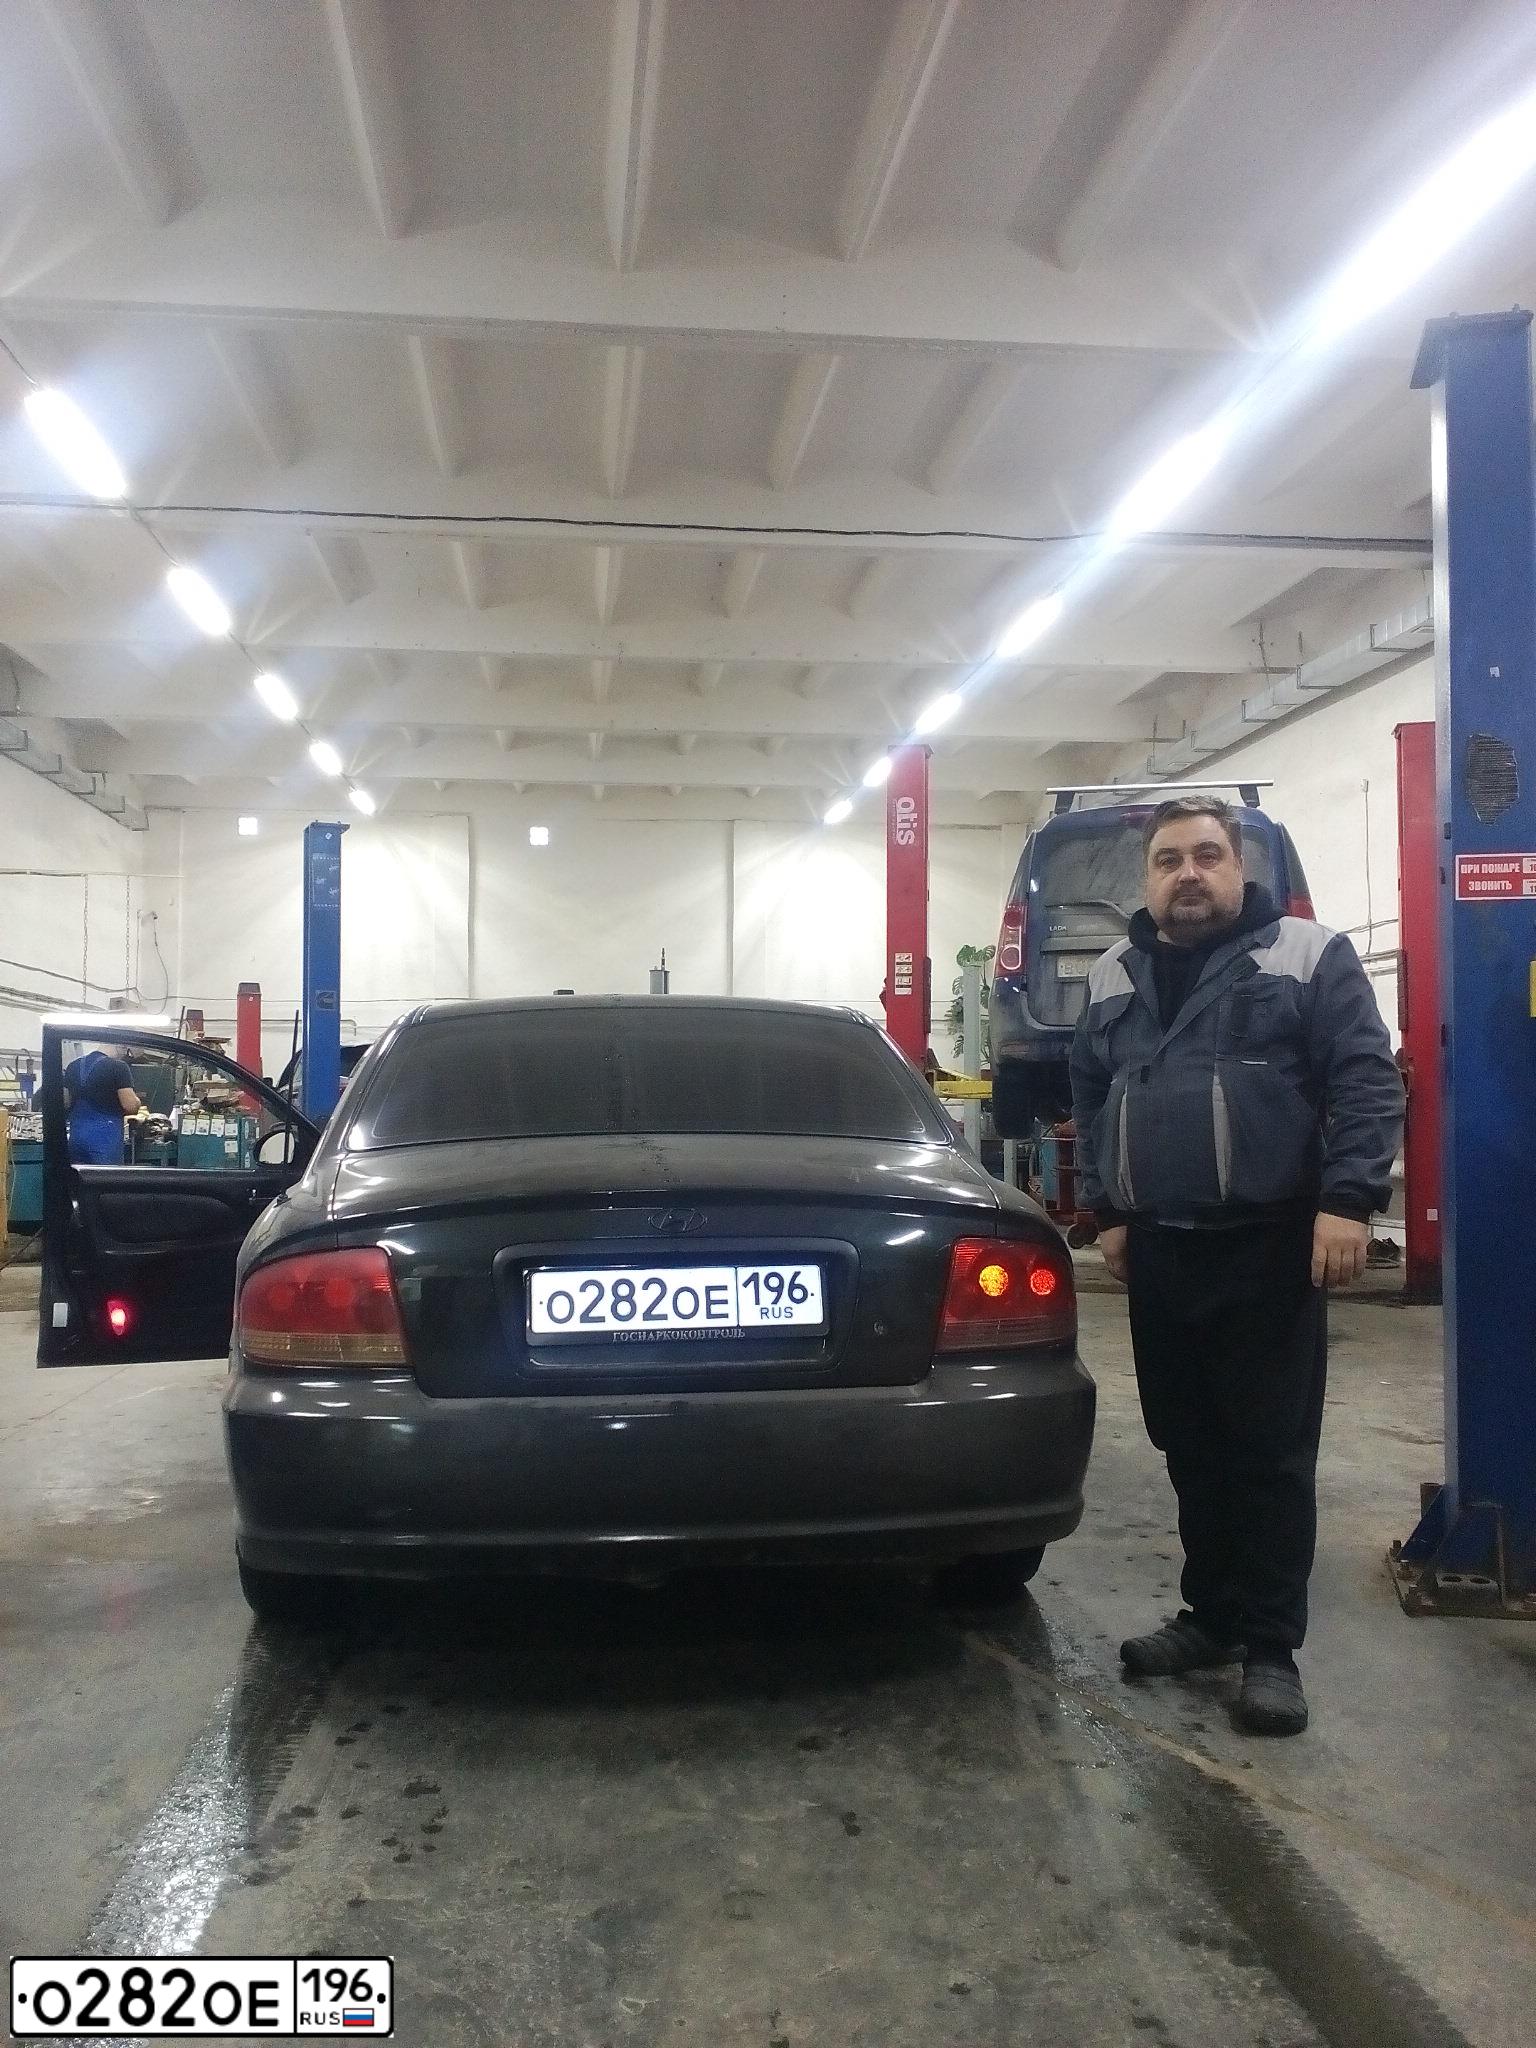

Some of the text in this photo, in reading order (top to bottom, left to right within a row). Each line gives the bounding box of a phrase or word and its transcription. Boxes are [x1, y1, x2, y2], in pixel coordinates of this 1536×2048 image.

[1460, 862, 1520, 874] ПРИ ПОЖАРЕ
[1468, 880, 1513, 891] ЗВОНИТЬ
[742, 1271, 808, 1306] 196
[759, 1306, 794, 1320] RUS
[613, 1328, 746, 1342] ГОСНАРКОКОНТРОЛЬ
